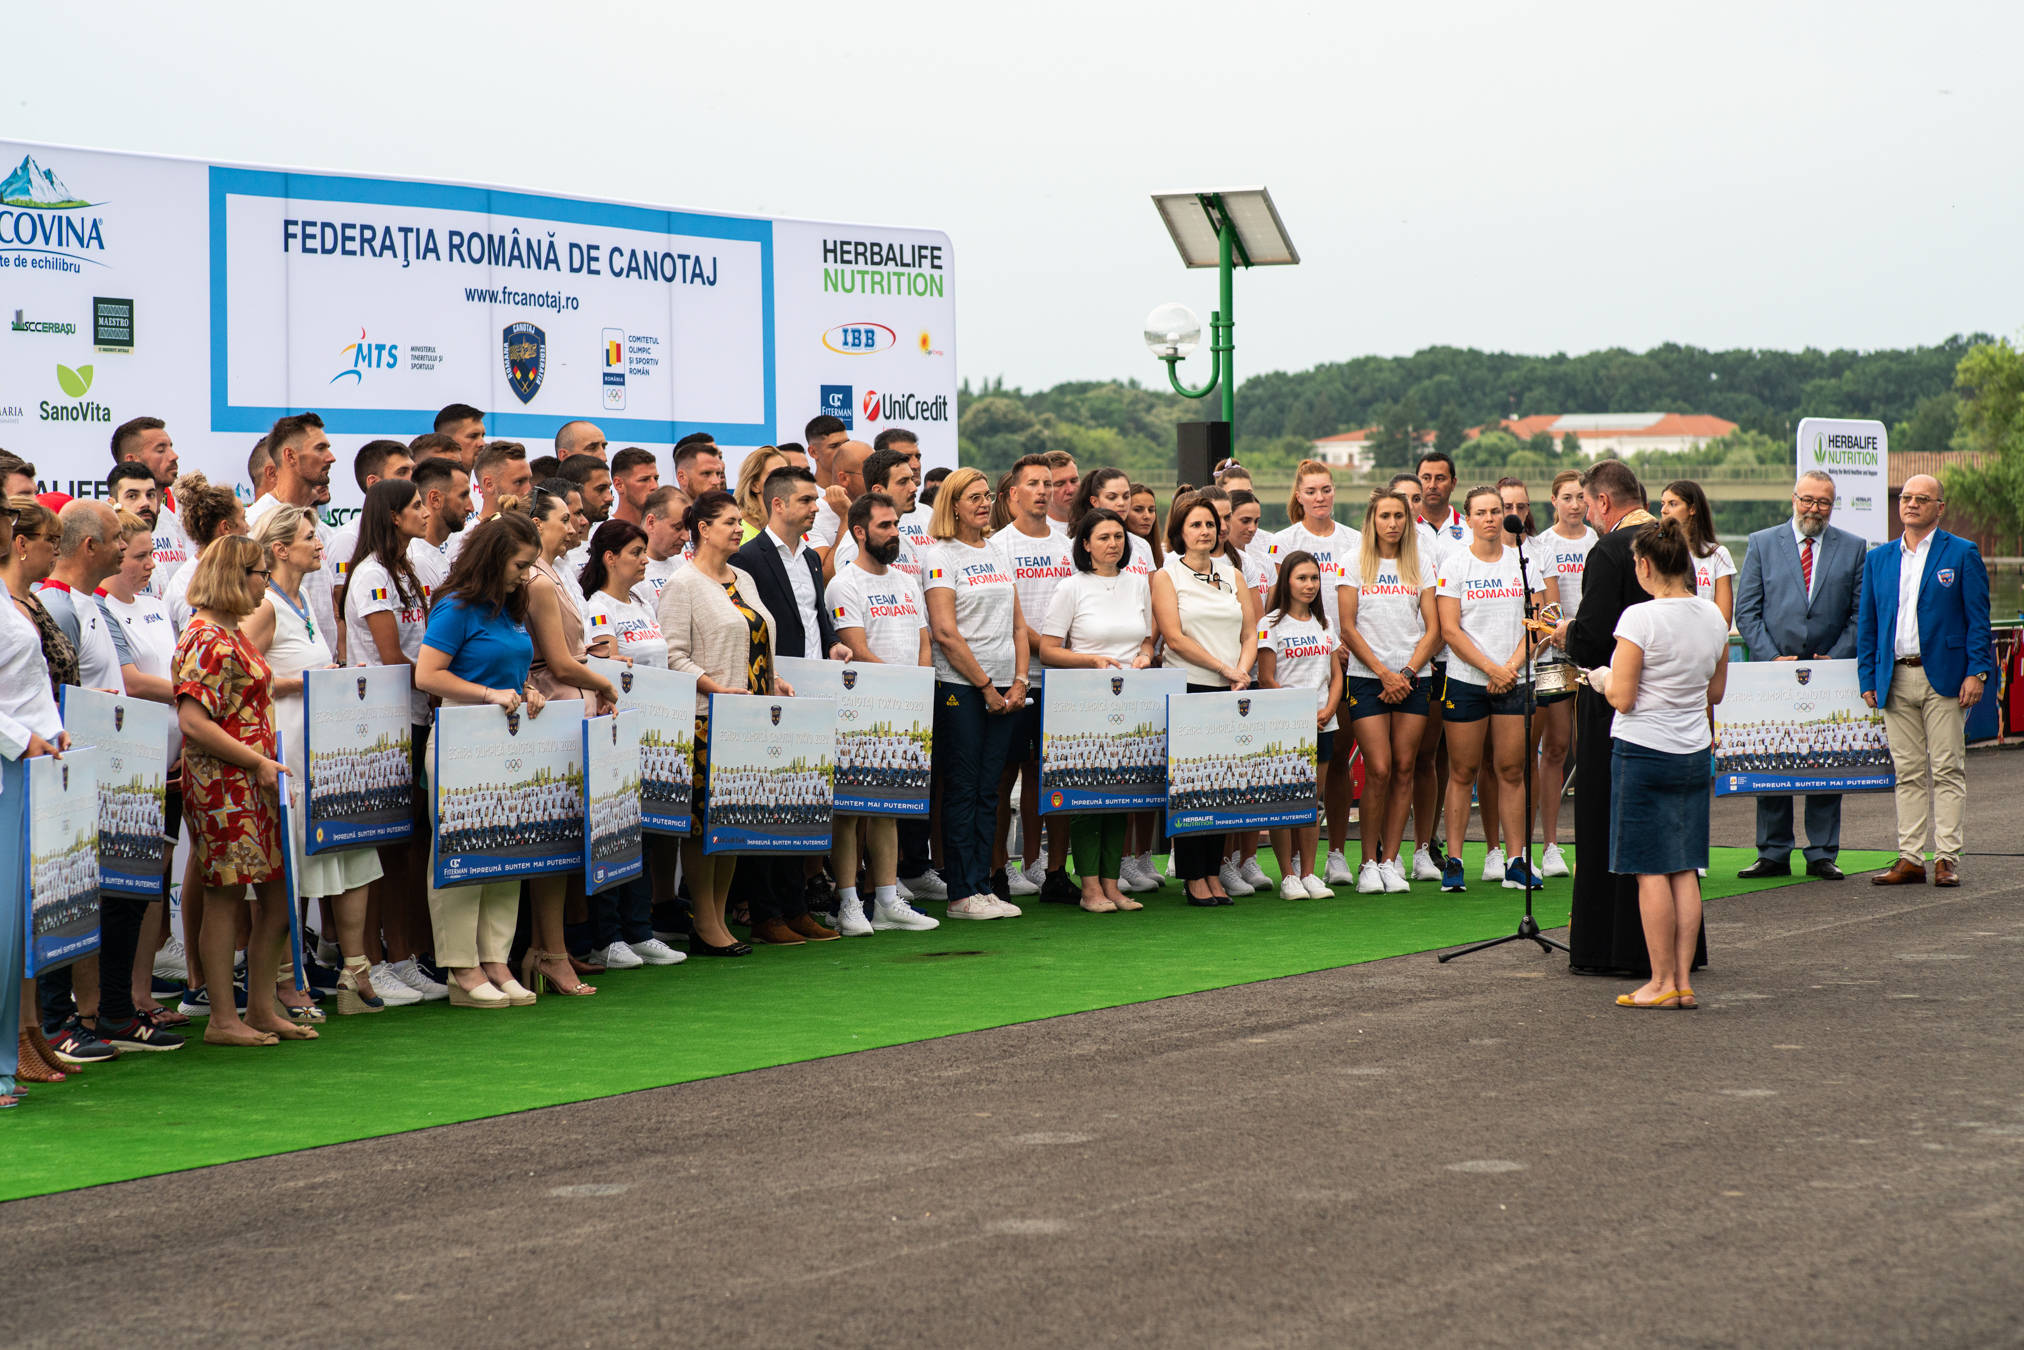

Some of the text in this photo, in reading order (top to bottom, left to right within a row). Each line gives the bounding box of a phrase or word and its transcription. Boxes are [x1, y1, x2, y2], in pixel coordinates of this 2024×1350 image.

[0, 211, 104, 250] COVINA
[449, 228, 561, 272] ROMÂNĂ
[569, 242, 600, 275] DE
[609, 246, 717, 286] CANOTAJ
[823, 239, 943, 270] HERBALIFE
[0, 254, 80, 273] te de echilibru
[823, 267, 943, 298] NUTRITION
[465, 286, 579, 314] www.frcanotaj.ro
[98, 317, 129, 327] MAESTRO
[512, 323, 536, 334] CANOTAJ
[628, 335, 659, 345] COMITETUL
[842, 328, 875, 348] IBB
[354, 343, 398, 369] MTS
[628, 347, 651, 355] OLIMPIC
[636, 358, 659, 366] SPORTIV
[0, 406, 24, 416] ARIA
[39, 400, 111, 422] SanoVita
[821, 406, 852, 417] FITERMAN
[882, 392, 948, 421] UniCredit
[1828, 434, 1878, 450] HERBALIFE
[1828, 450, 1878, 466] NUTRITION
[899, 525, 923, 536] EAM
[152, 538, 172, 550] EAM
[1015, 556, 1051, 567] TEAM
[1313, 552, 1331, 562] AM
[1556, 553, 1583, 563] EAM
[963, 563, 996, 577] TEAM
[1016, 567, 1072, 579] ROMANIA
[1466, 578, 1503, 590] TEAM
[1467, 587, 1525, 601] ROMANIA
[617, 618, 649, 631] TEAM
[1283, 635, 1318, 648] TEAM
[834, 799, 864, 807] SUNTEM
[884, 802, 924, 810] PUTERNICI!
[652, 817, 686, 827] PUTERNICI!
[1246, 816, 1267, 824] SUNTEM
[1282, 812, 1312, 821] PUTERNICI!
[505, 861, 530, 871] SUNTEM
[533, 858, 544, 867] MAI
[443, 868, 468, 876] FITERMAN
